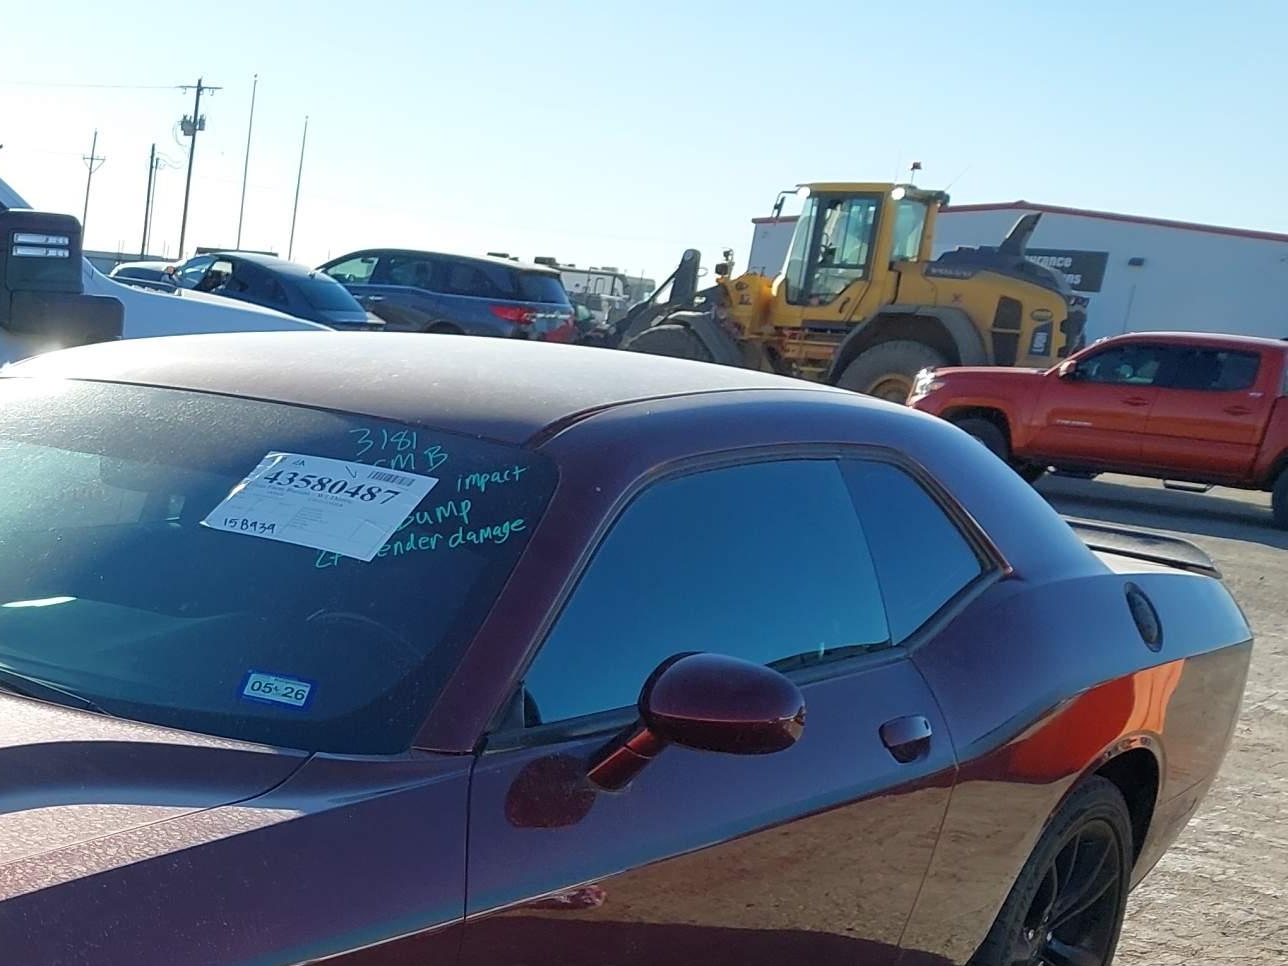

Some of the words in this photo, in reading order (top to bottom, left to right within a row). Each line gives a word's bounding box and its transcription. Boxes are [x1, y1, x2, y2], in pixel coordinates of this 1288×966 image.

[349, 428, 418, 456] 3181
[263, 469, 402, 505] 43580487
[456, 465, 528, 493] impact
[376, 534, 443, 558] ender
[250, 680, 274, 694] 05
[281, 686, 307, 701] 26
